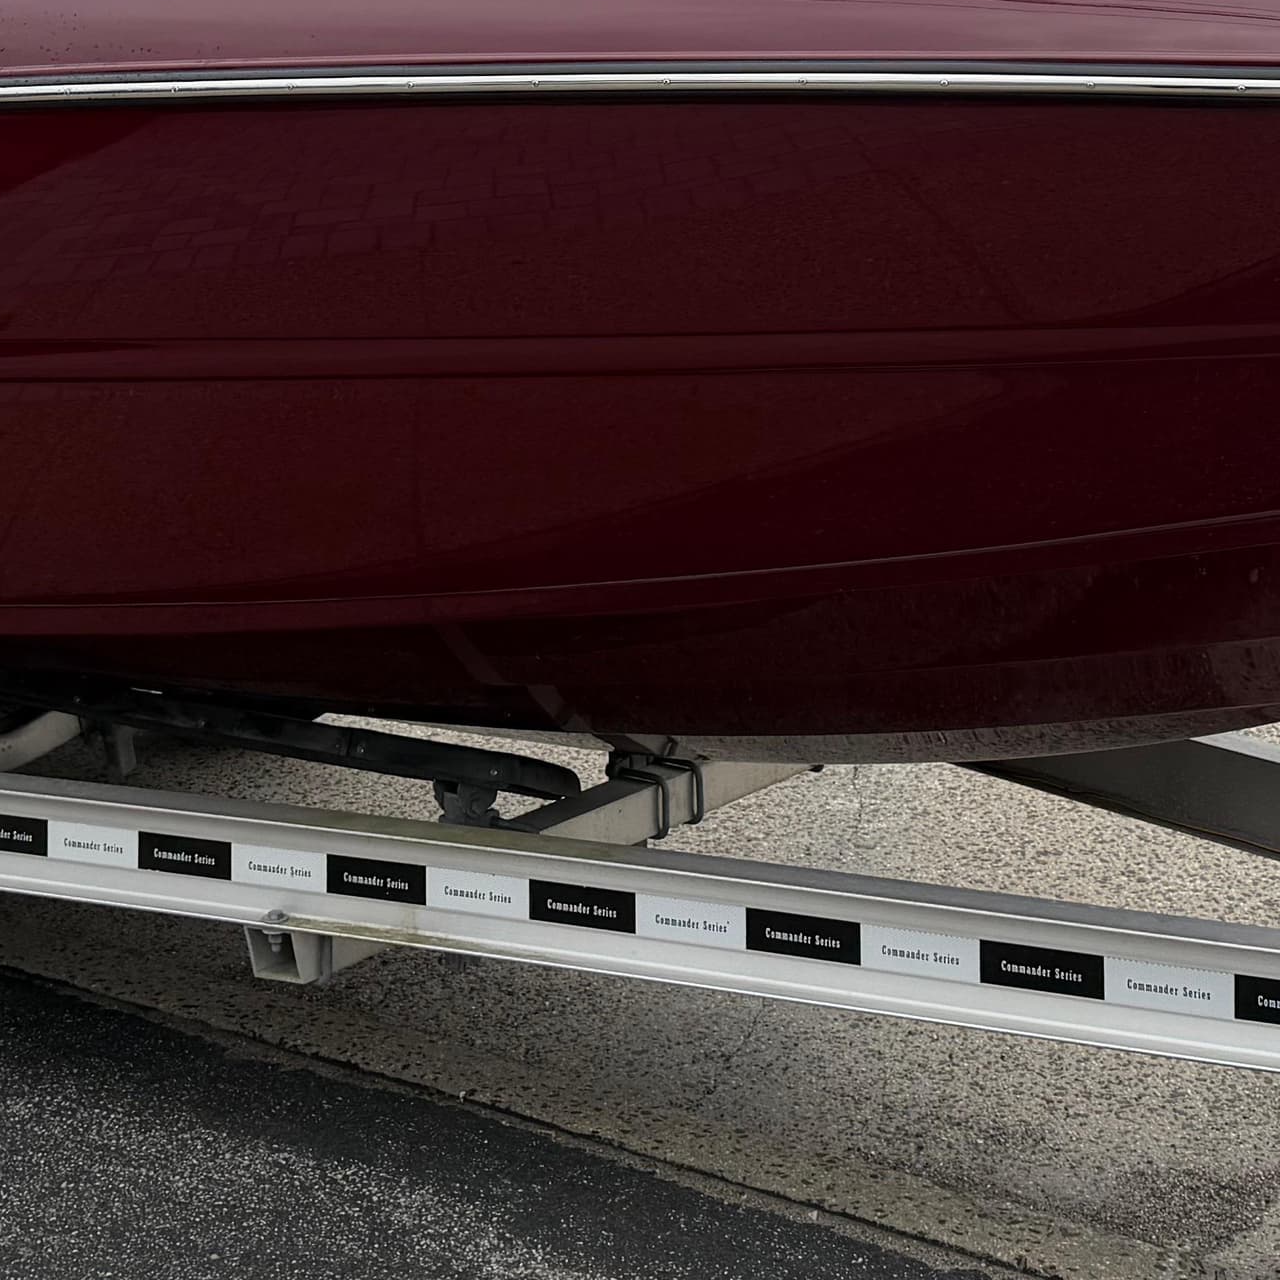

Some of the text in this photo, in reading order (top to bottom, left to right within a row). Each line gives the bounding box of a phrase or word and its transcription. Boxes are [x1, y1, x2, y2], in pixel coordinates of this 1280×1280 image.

[12, 830, 33, 842] Series
[63, 837, 123, 855] Commander Series
[153, 847, 216, 866] Commander Series
[248, 860, 312, 878] Commander Series
[343, 871, 409, 891] Commander Series
[444, 885, 512, 904] Commander Series
[547, 898, 617, 918] Commander Series
[655, 914, 728, 934] Commander Series
[765, 927, 841, 949] Commander Series
[881, 944, 960, 966] Commander Series
[1000, 959, 1082, 982] Commander Series
[1127, 978, 1211, 1001] Commander Series
